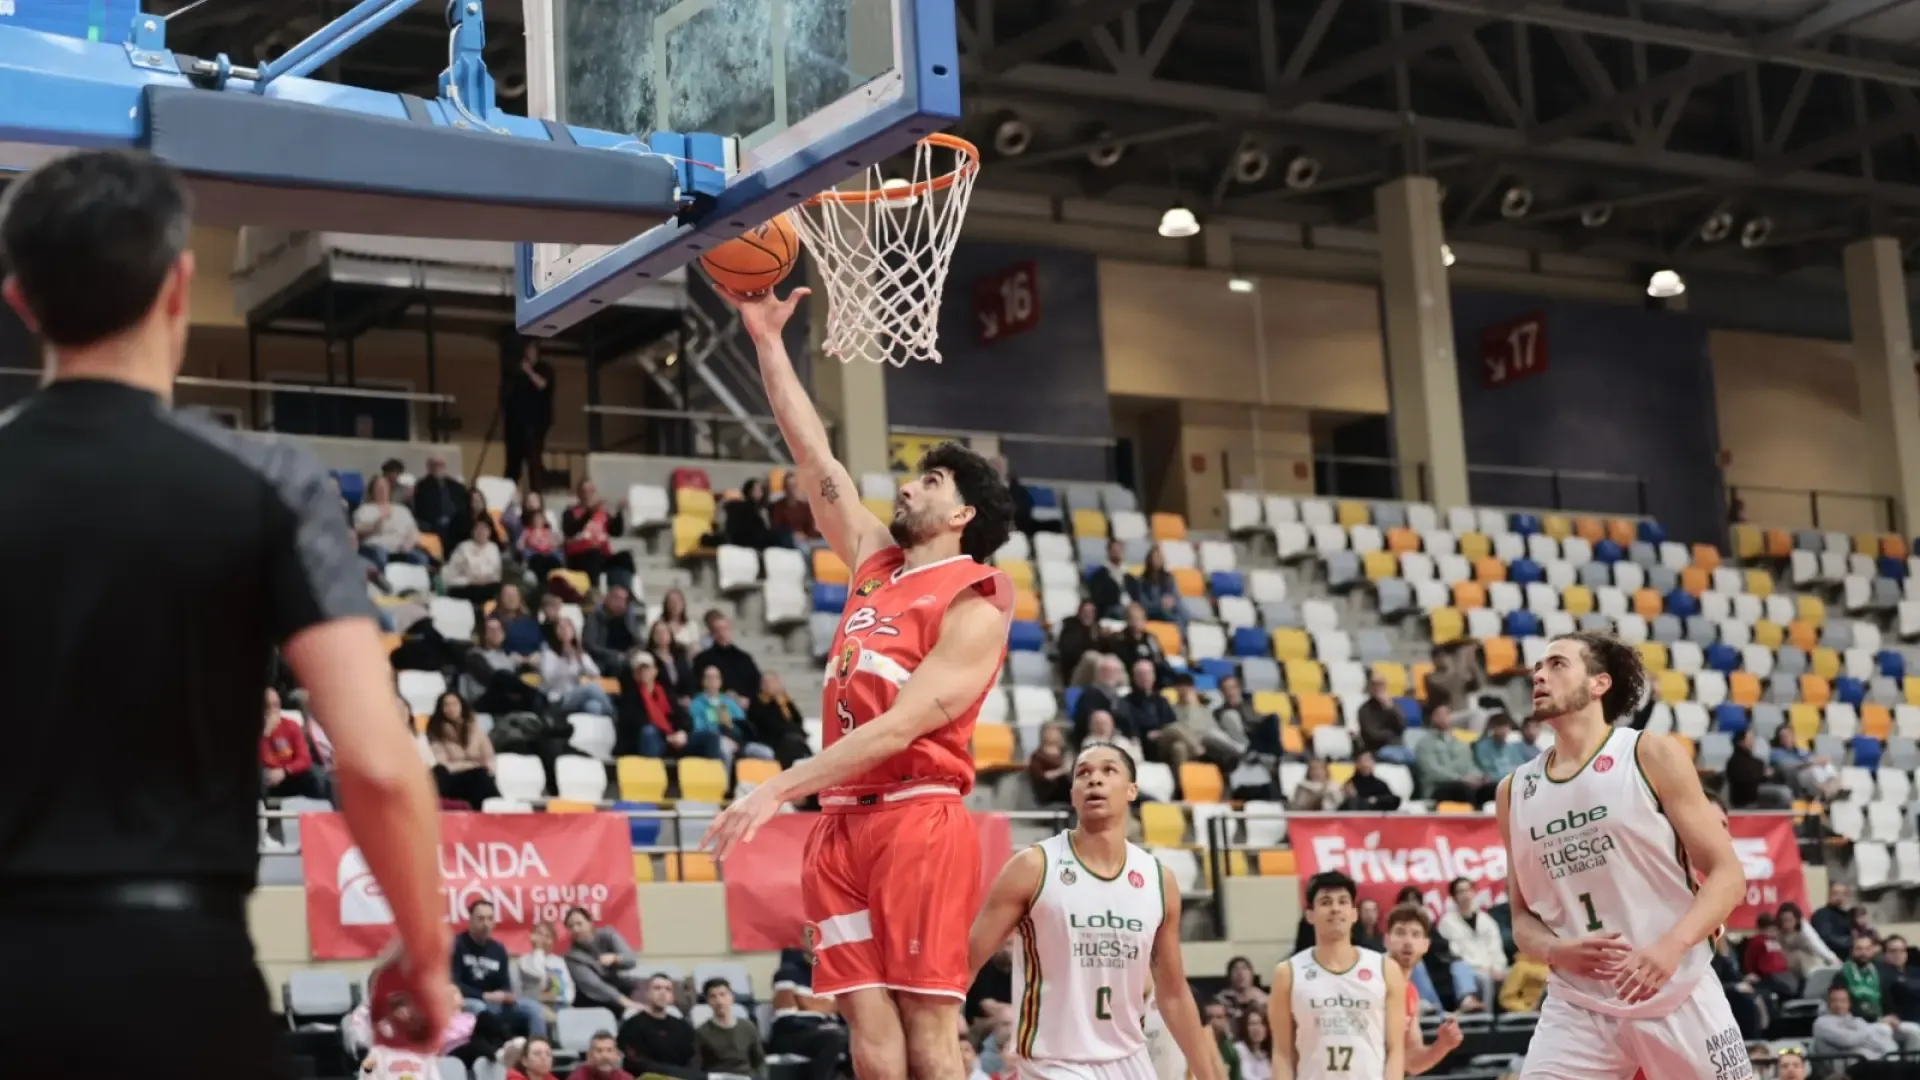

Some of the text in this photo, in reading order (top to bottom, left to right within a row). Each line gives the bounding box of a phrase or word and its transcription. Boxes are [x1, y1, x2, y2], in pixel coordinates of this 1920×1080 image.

[1001, 271, 1032, 326] 16
[1507, 320, 1539, 371] 17
[1530, 805, 1608, 841] Lobe
[530, 883, 609, 903] GRUPO
[1070, 909, 1143, 932] Lobe
[1579, 892, 1603, 932] 1
[1310, 993, 1370, 1009] Lobe
[1326, 1046, 1354, 1071] 17
